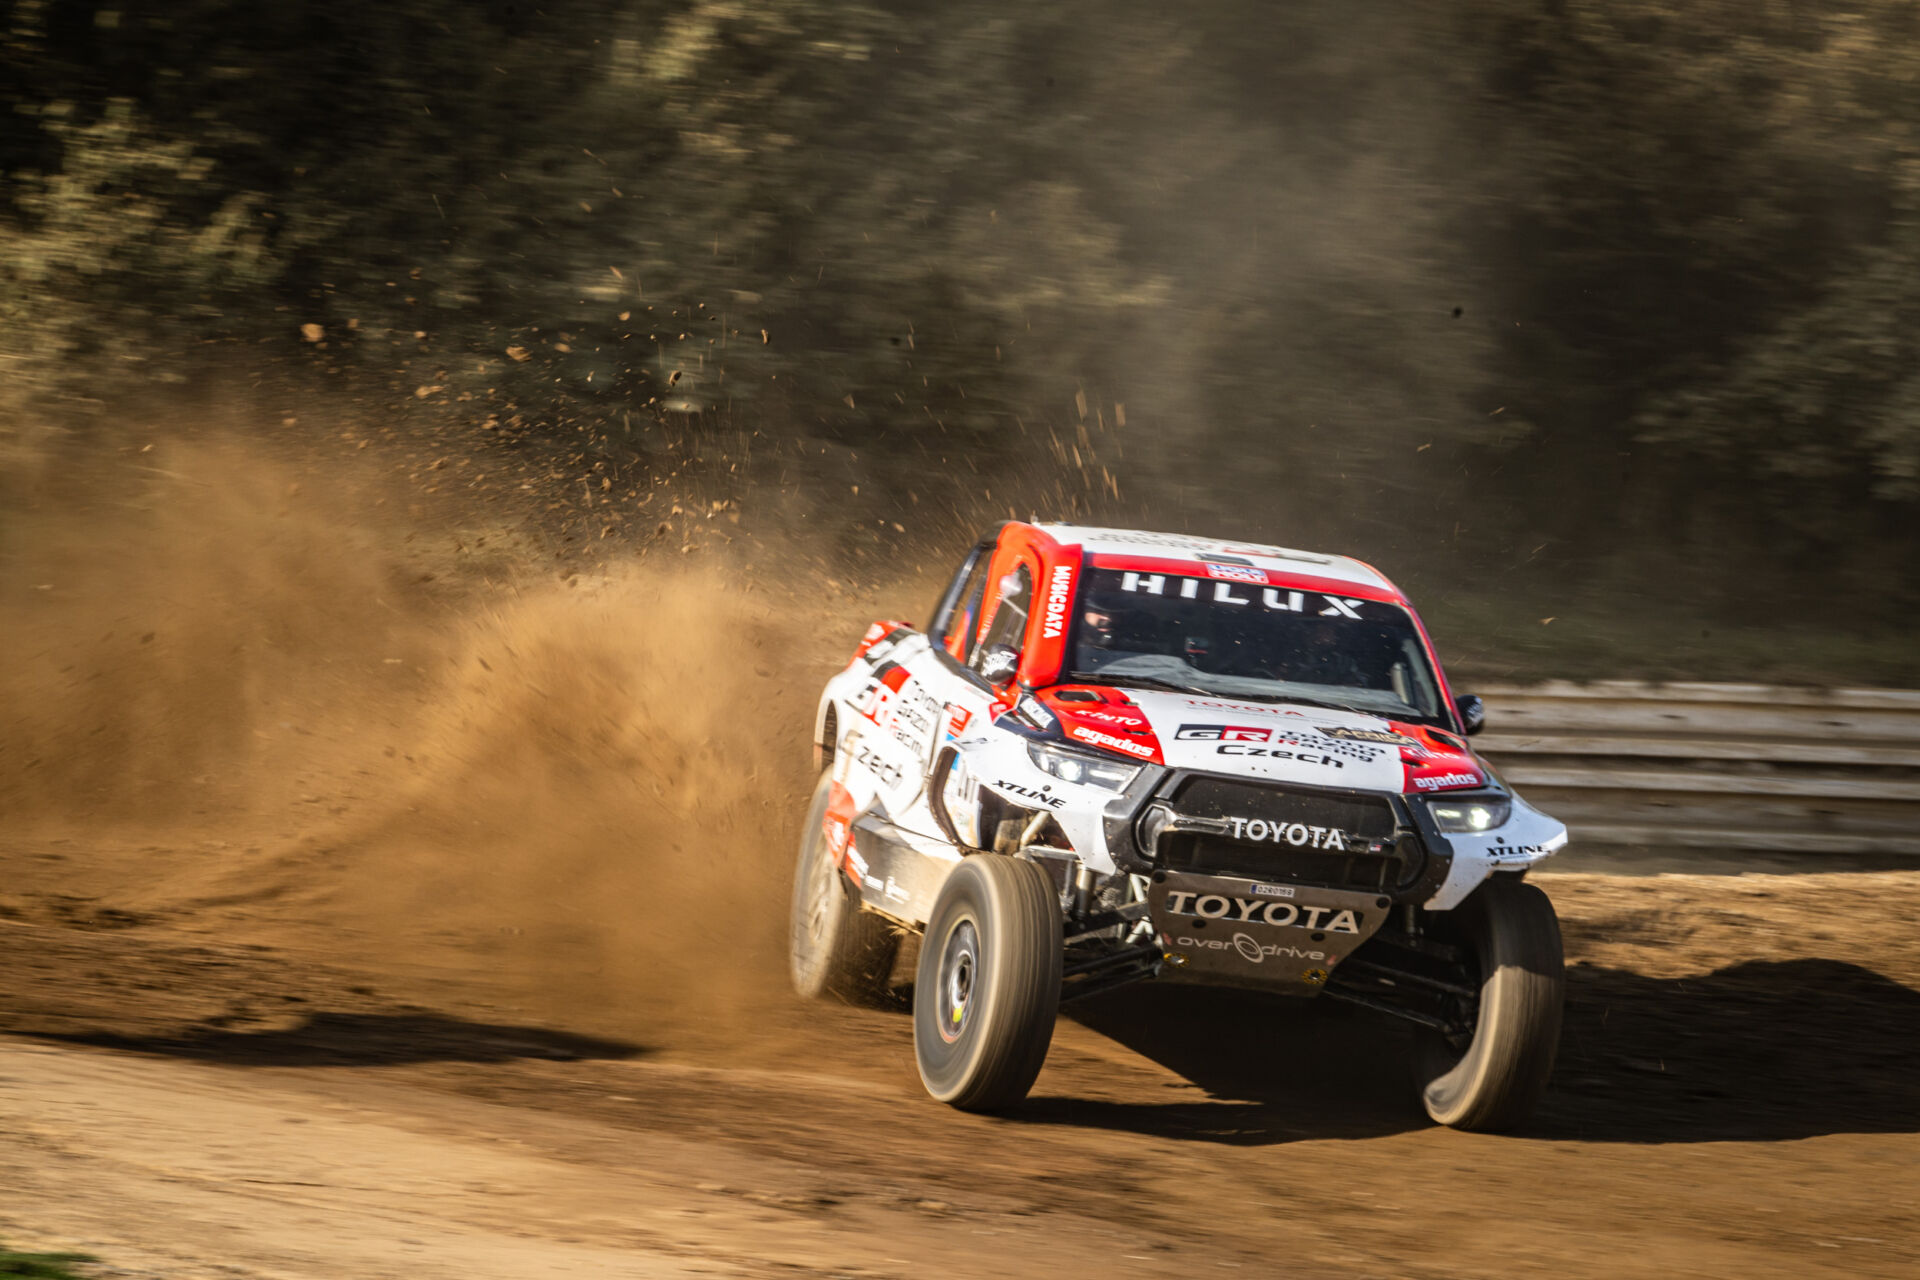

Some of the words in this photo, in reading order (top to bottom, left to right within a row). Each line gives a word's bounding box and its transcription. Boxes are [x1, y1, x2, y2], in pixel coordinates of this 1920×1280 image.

[1043, 566, 1072, 638] MUSICDATA
[1121, 571, 1364, 620] HILUX
[1075, 709, 1143, 726] KINTO
[1184, 699, 1305, 717] TOYOTA
[1073, 726, 1155, 757] agados
[1175, 726, 1272, 742] GR
[1279, 730, 1386, 754] TOYOTA
[1279, 734, 1376, 757] GAZOO
[1216, 744, 1344, 769] Czech
[1278, 738, 1374, 763] Racing
[992, 780, 1066, 808] XTLINE
[1413, 772, 1478, 791] agados
[1230, 816, 1345, 850] TOYOTA
[1167, 890, 1360, 934] TOYOTA
[1177, 936, 1233, 951] over
[1261, 943, 1325, 961] drive
